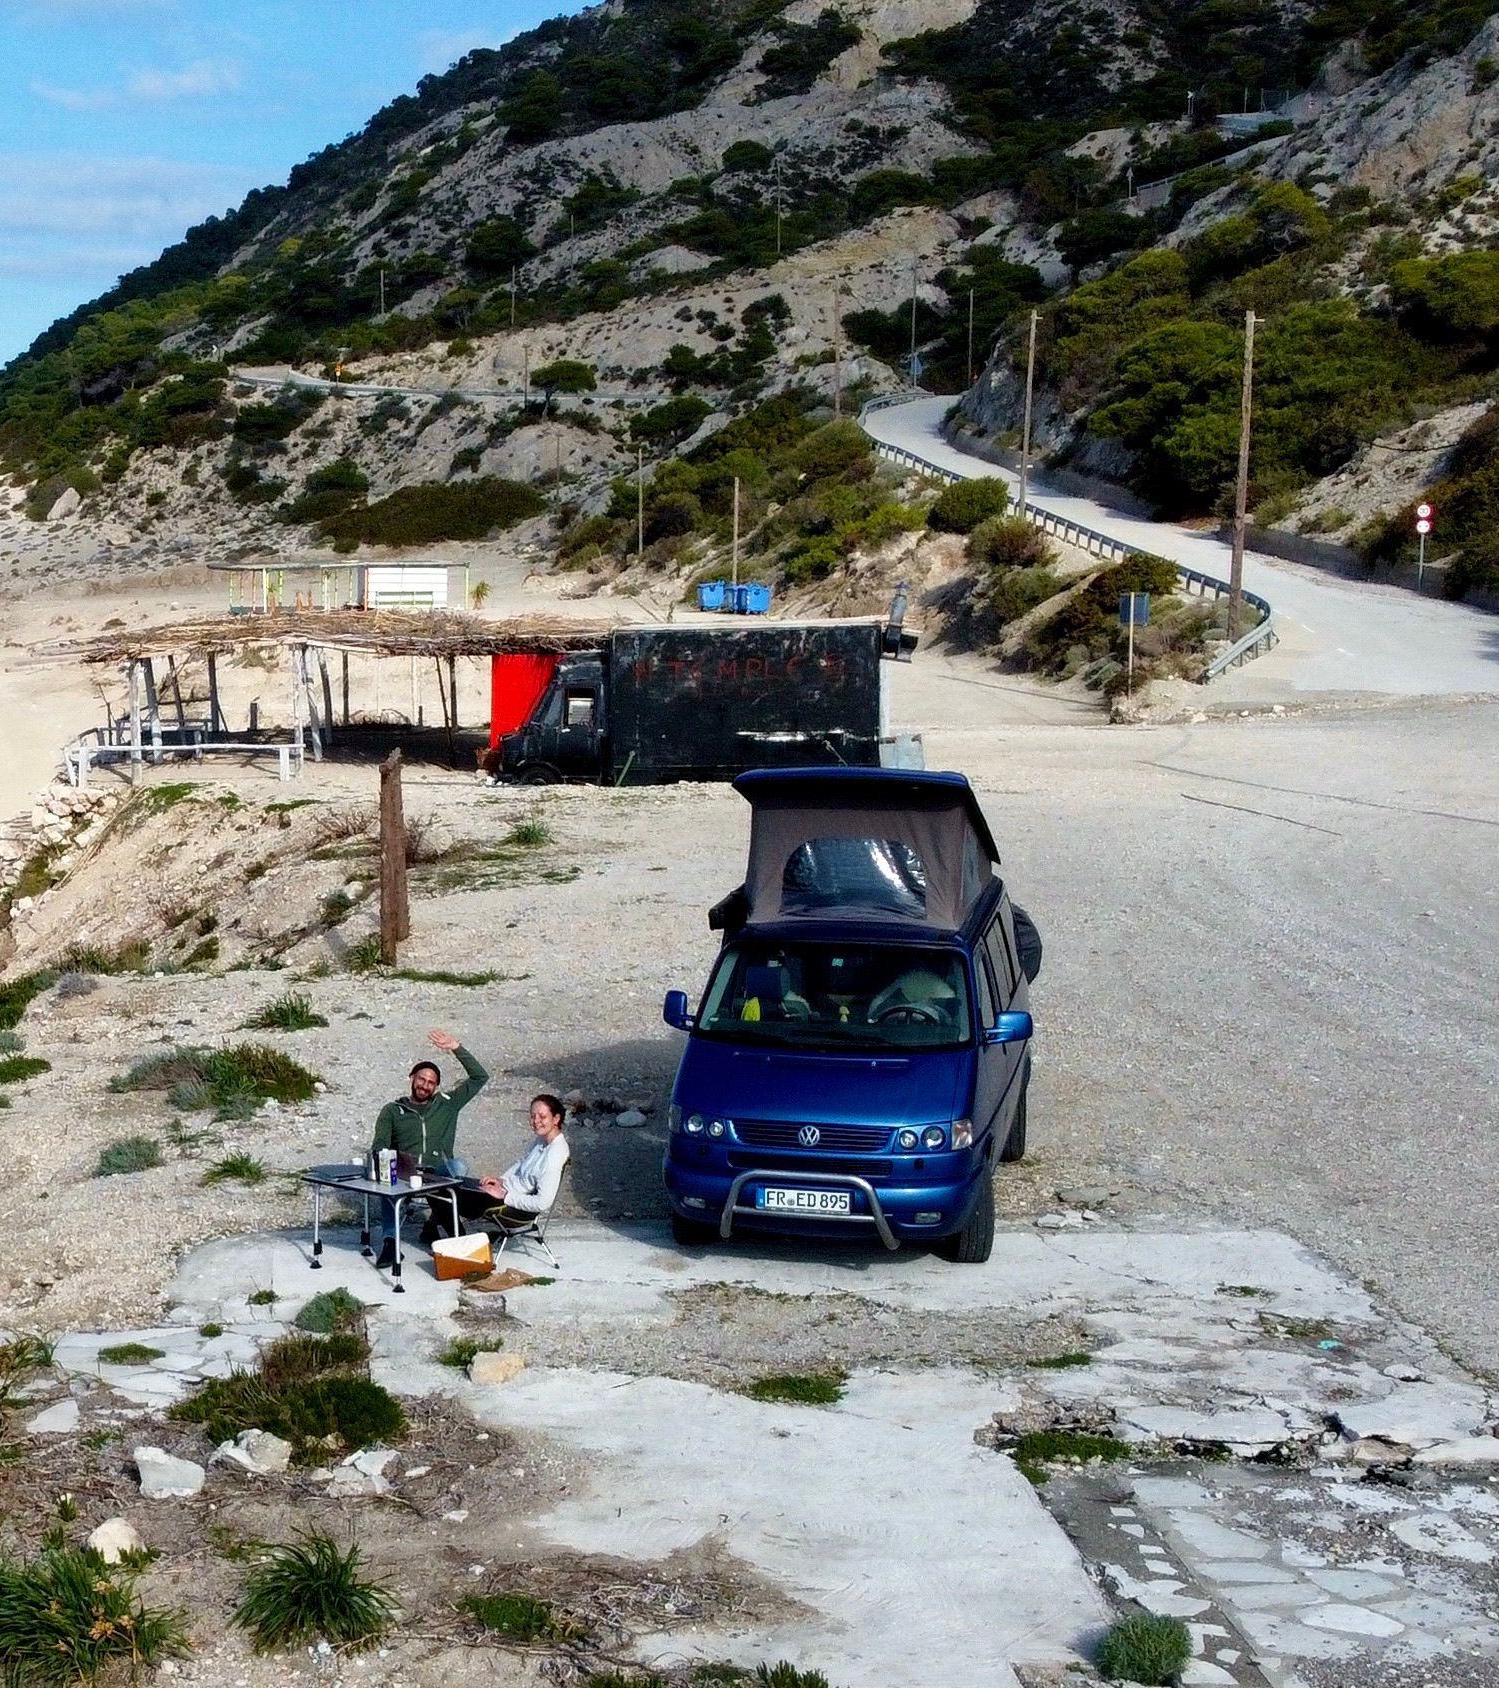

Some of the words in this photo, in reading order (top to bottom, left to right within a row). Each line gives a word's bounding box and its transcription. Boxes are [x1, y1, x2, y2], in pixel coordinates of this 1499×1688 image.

[799, 1126, 820, 1146] VW
[766, 1190, 786, 1206] FR
[796, 1192, 817, 1208] ED
[819, 1194, 848, 1210] 895
